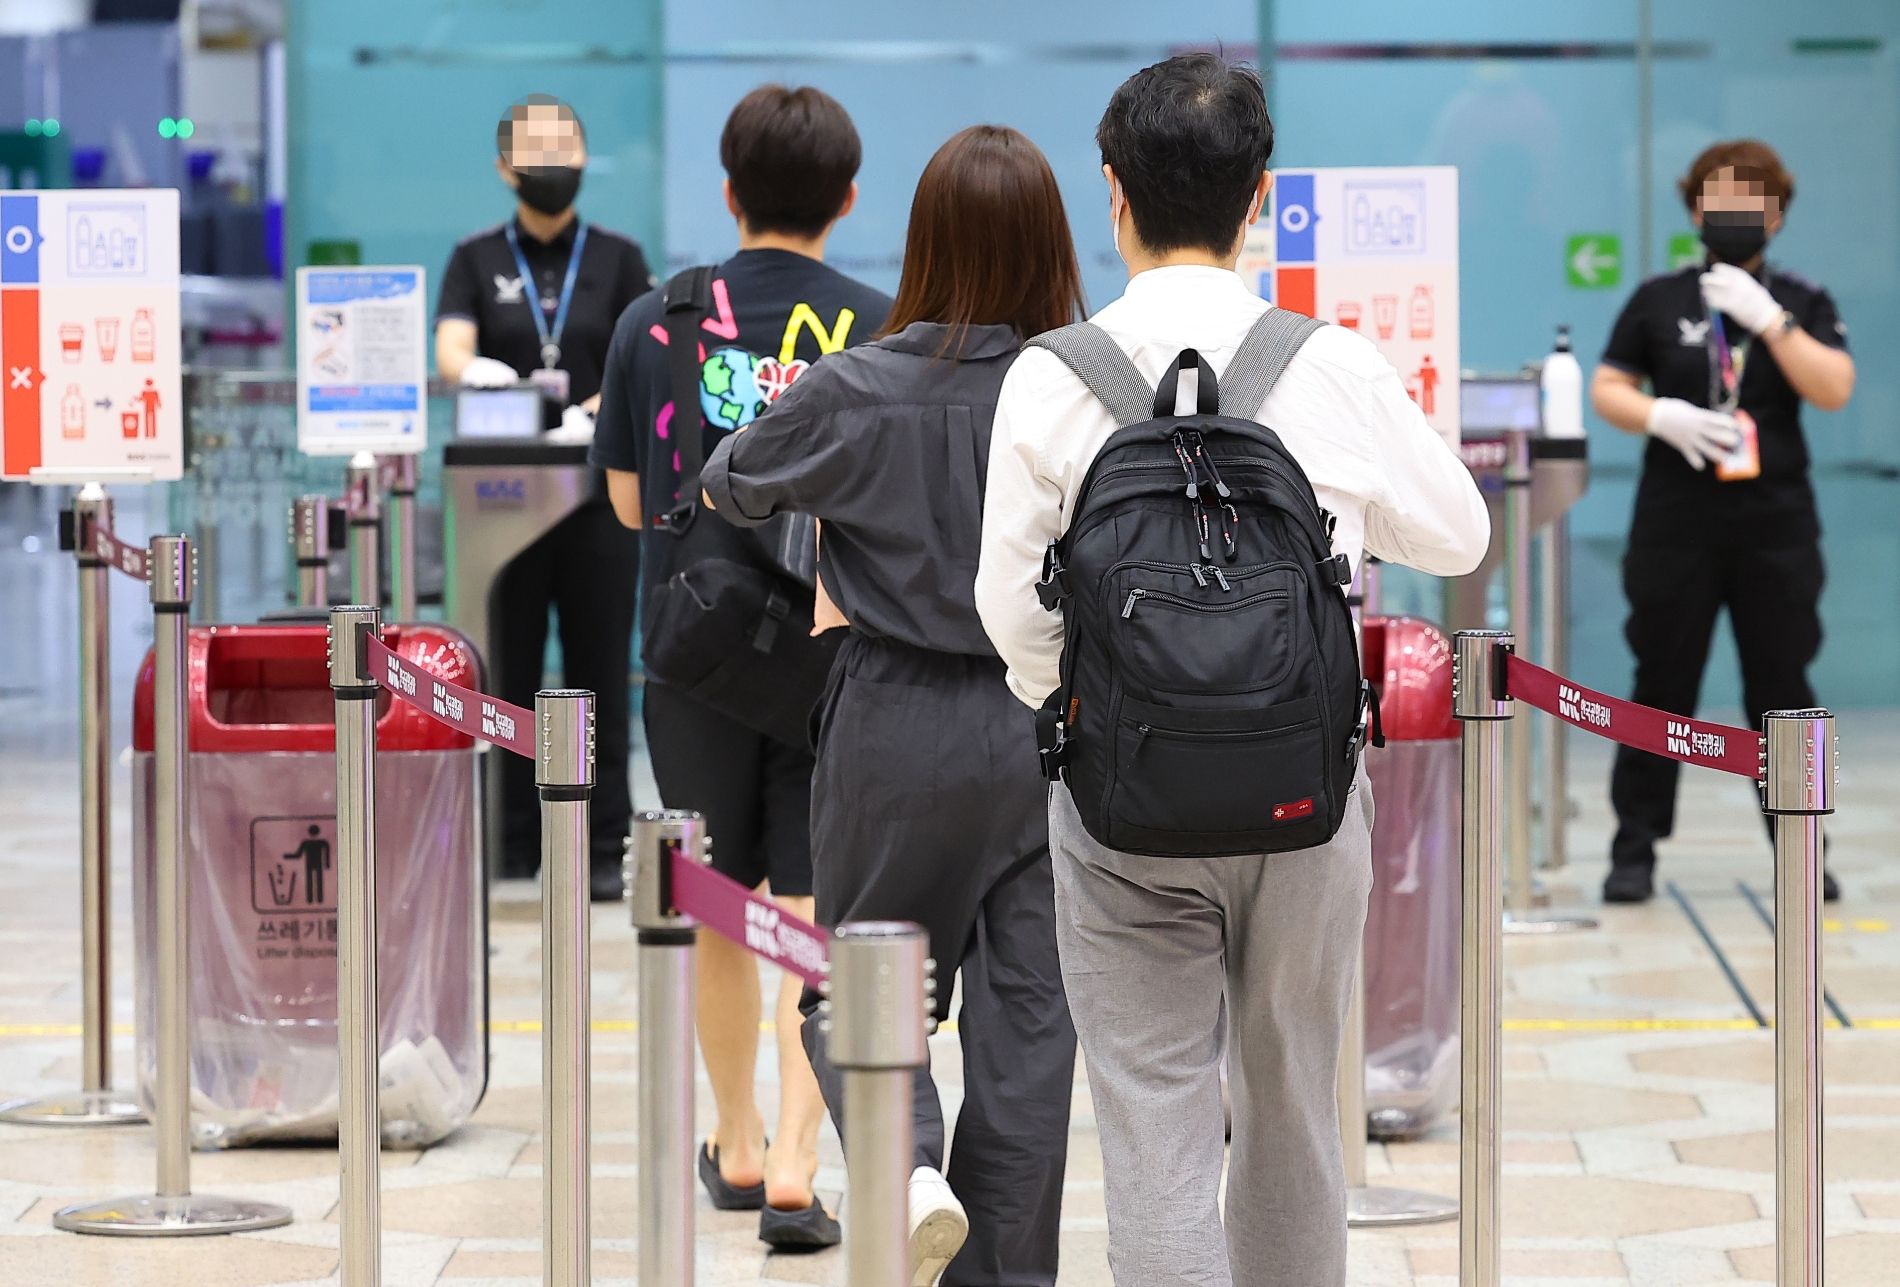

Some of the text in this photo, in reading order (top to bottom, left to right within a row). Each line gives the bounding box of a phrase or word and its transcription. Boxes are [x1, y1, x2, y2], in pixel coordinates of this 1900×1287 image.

[1558, 684, 1612, 728] KAC 한국공항공사
[1667, 720, 1726, 758] KAC 한국공항공사
